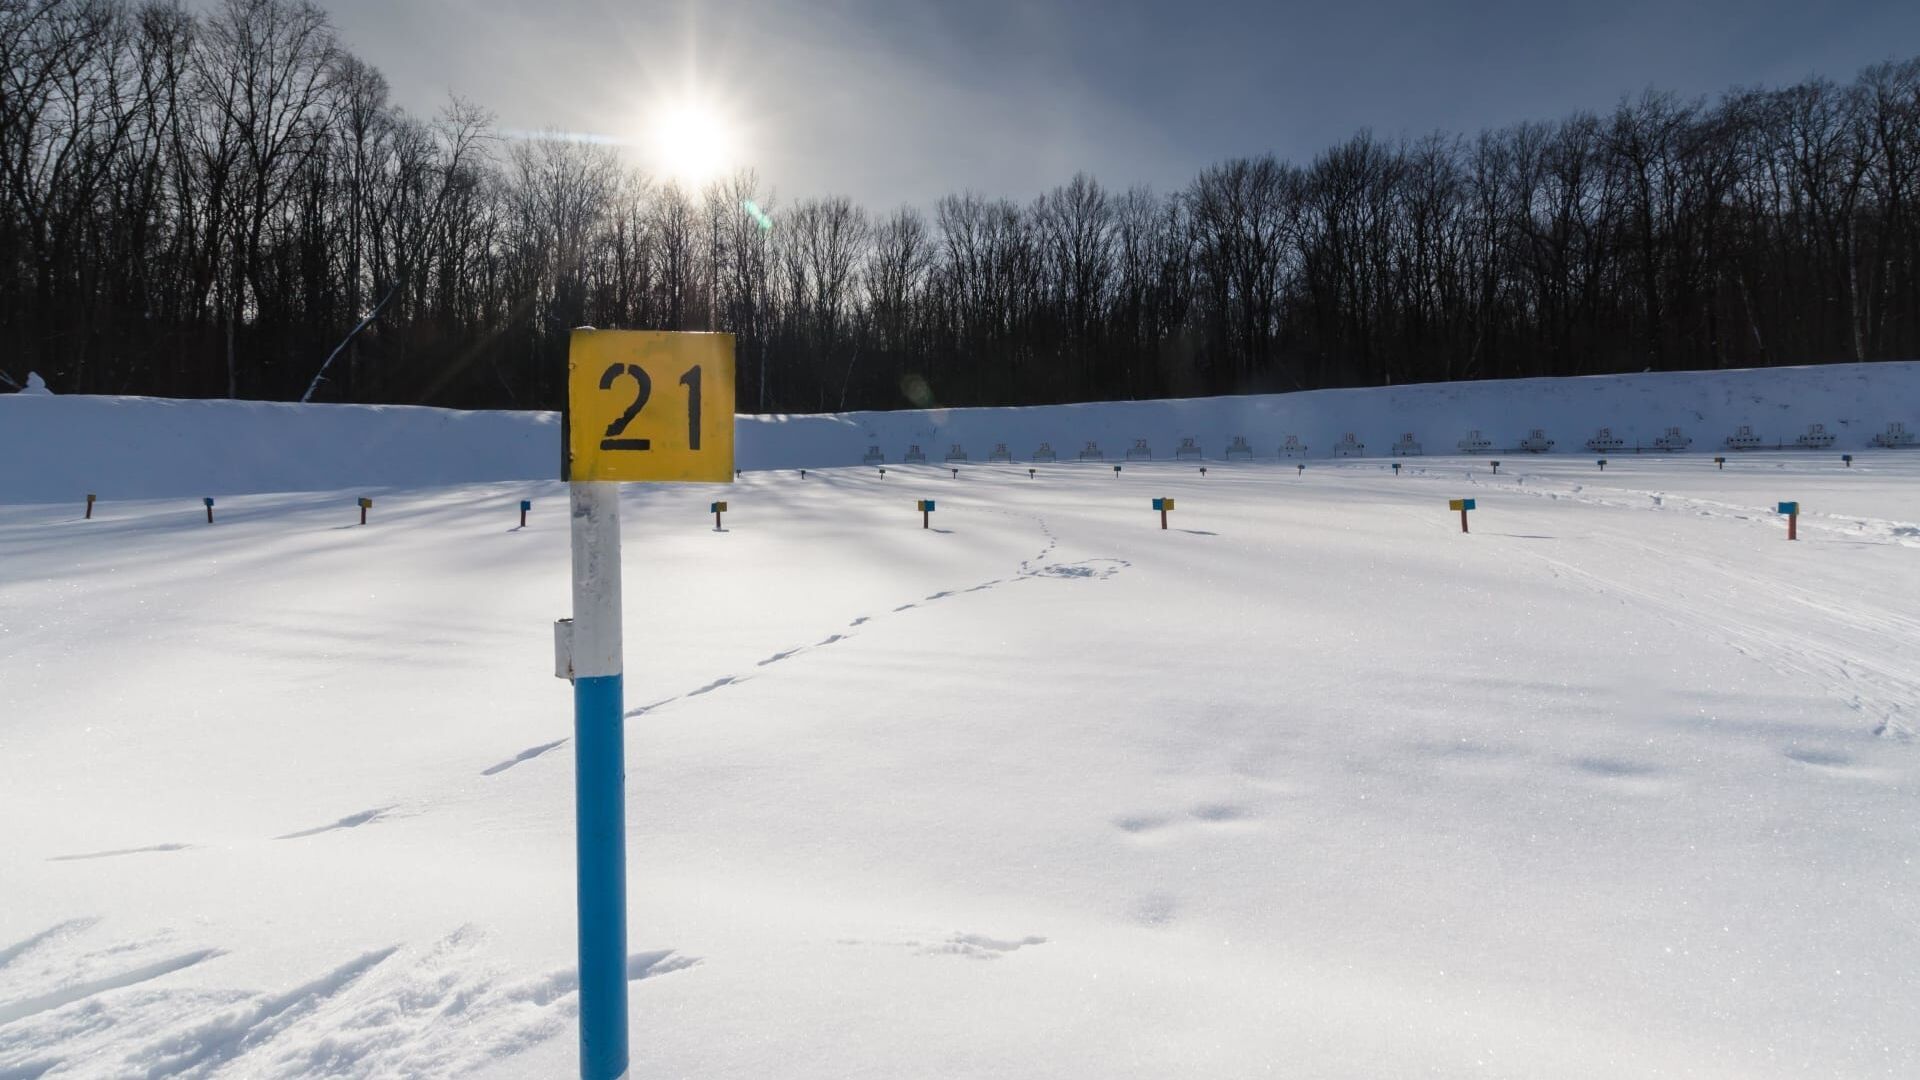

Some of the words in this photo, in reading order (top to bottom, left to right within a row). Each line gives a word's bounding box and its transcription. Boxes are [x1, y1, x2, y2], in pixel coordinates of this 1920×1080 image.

[599, 362, 702, 451] 21
[1811, 423, 1823, 435] 12
[1403, 432, 1413, 442] 18
